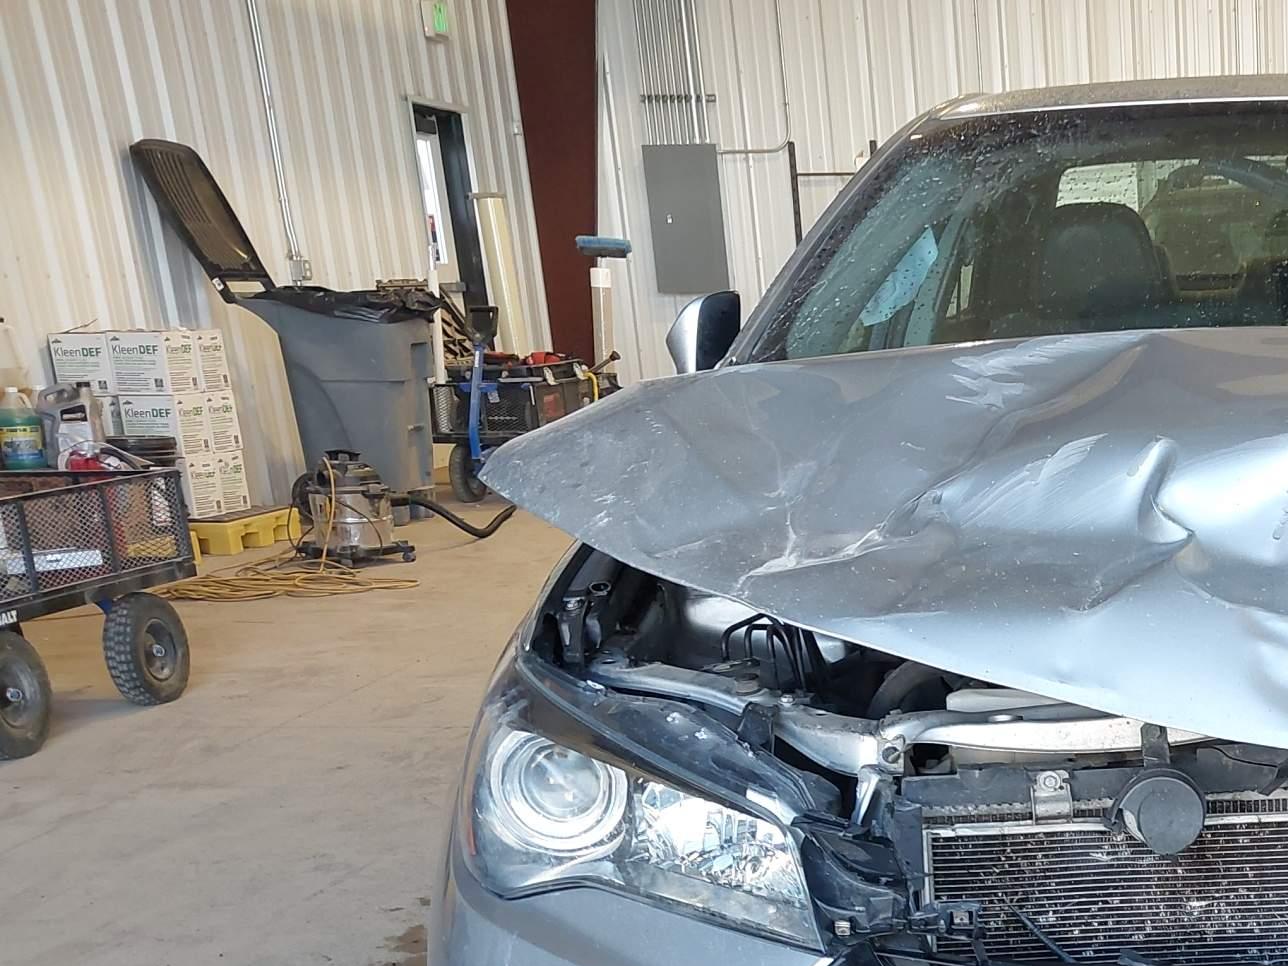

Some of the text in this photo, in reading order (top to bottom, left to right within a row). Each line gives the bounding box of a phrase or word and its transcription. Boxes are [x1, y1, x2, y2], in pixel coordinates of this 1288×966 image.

[53, 347, 102, 357] KleenDEF
[111, 345, 159, 355] KleenDEF
[124, 408, 172, 418] KleenDEF
[0, 610, 18, 626] ALT
